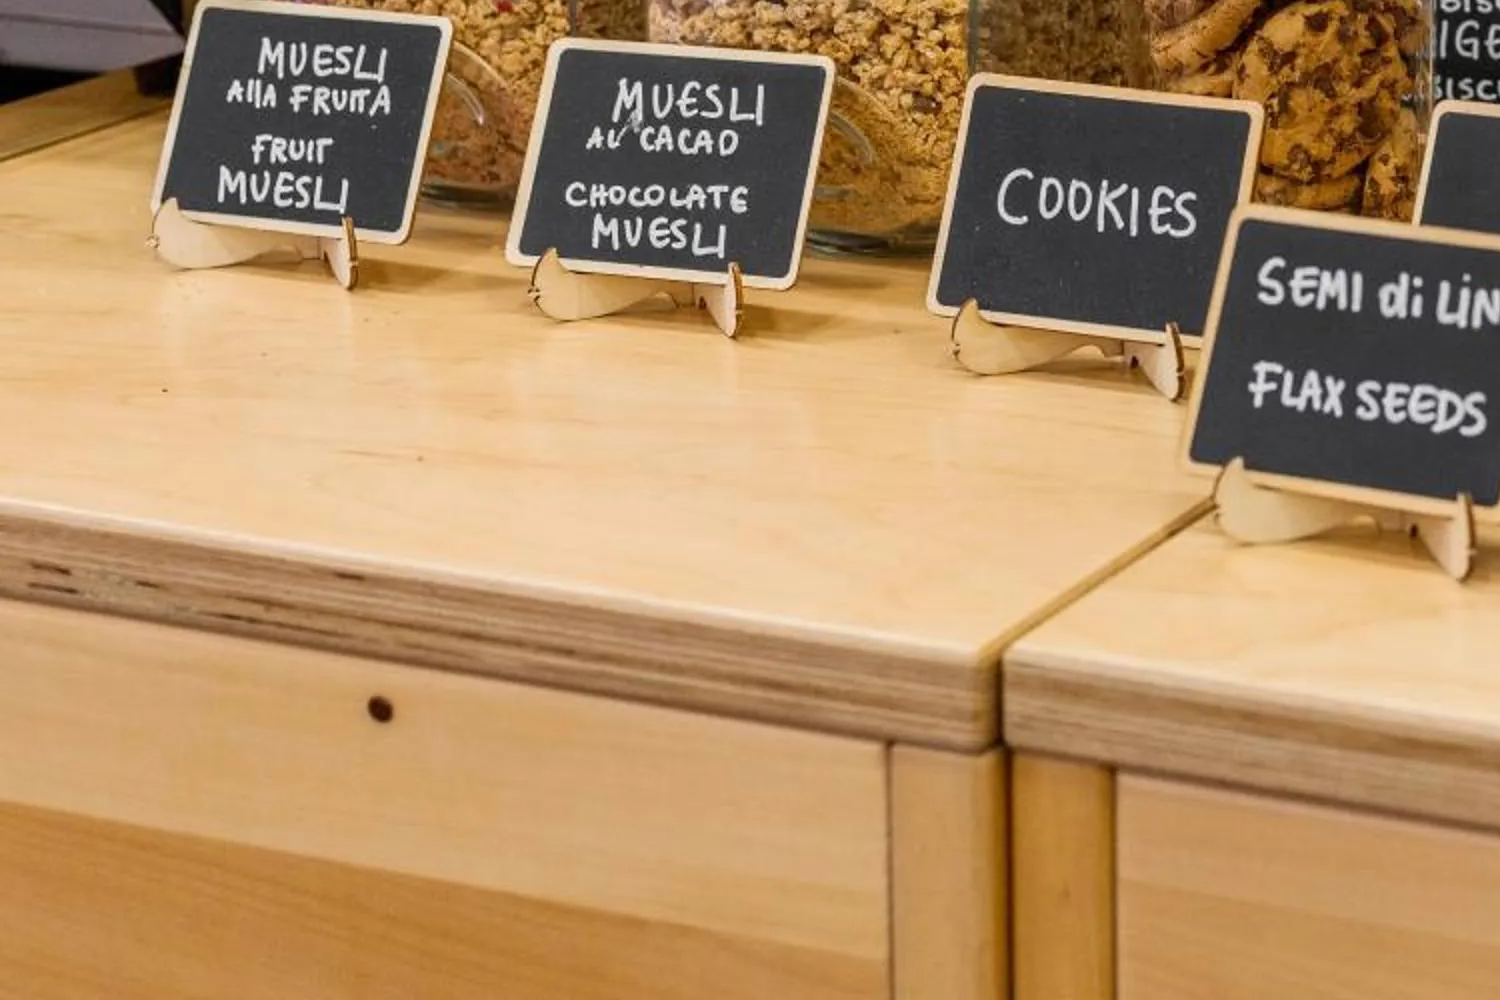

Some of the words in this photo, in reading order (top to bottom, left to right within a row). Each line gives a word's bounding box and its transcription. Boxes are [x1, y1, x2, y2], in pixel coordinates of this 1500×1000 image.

[257, 36, 388, 84] MUESLI
[611, 77, 765, 127] MUESLI
[251, 133, 334, 165] FRUIT
[639, 124, 739, 157] CACAO
[217, 164, 349, 214] MUESLI
[565, 181, 749, 214] CHOCOLATE
[997, 167, 1197, 238] COOKIES
[591, 213, 727, 259] MUESLI
[1257, 256, 1363, 313] SEMI
[1378, 271, 1423, 319] di
[1247, 360, 1346, 418] FLAX
[1355, 380, 1488, 438] SEEDS
